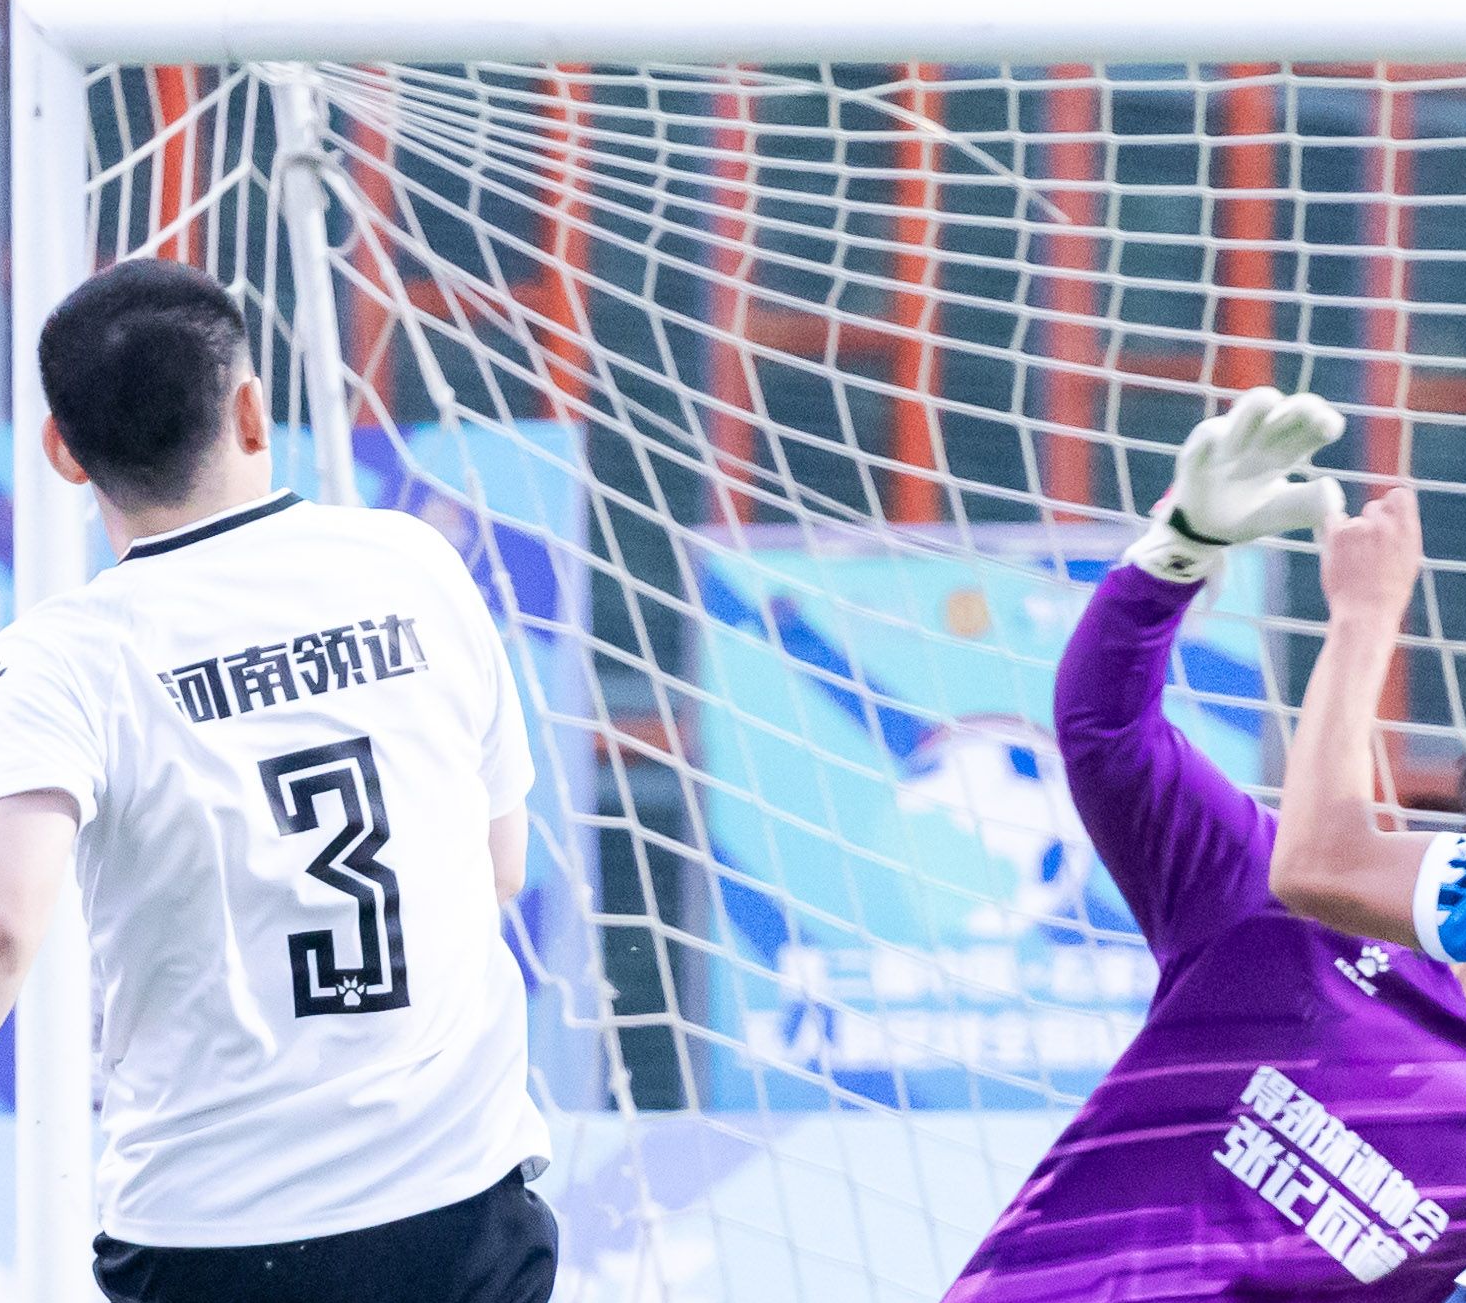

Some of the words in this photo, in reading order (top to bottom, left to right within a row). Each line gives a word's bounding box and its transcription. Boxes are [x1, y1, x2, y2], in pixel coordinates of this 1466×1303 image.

[156, 613, 430, 724] 河南领达
[257, 735, 411, 1018] 3
